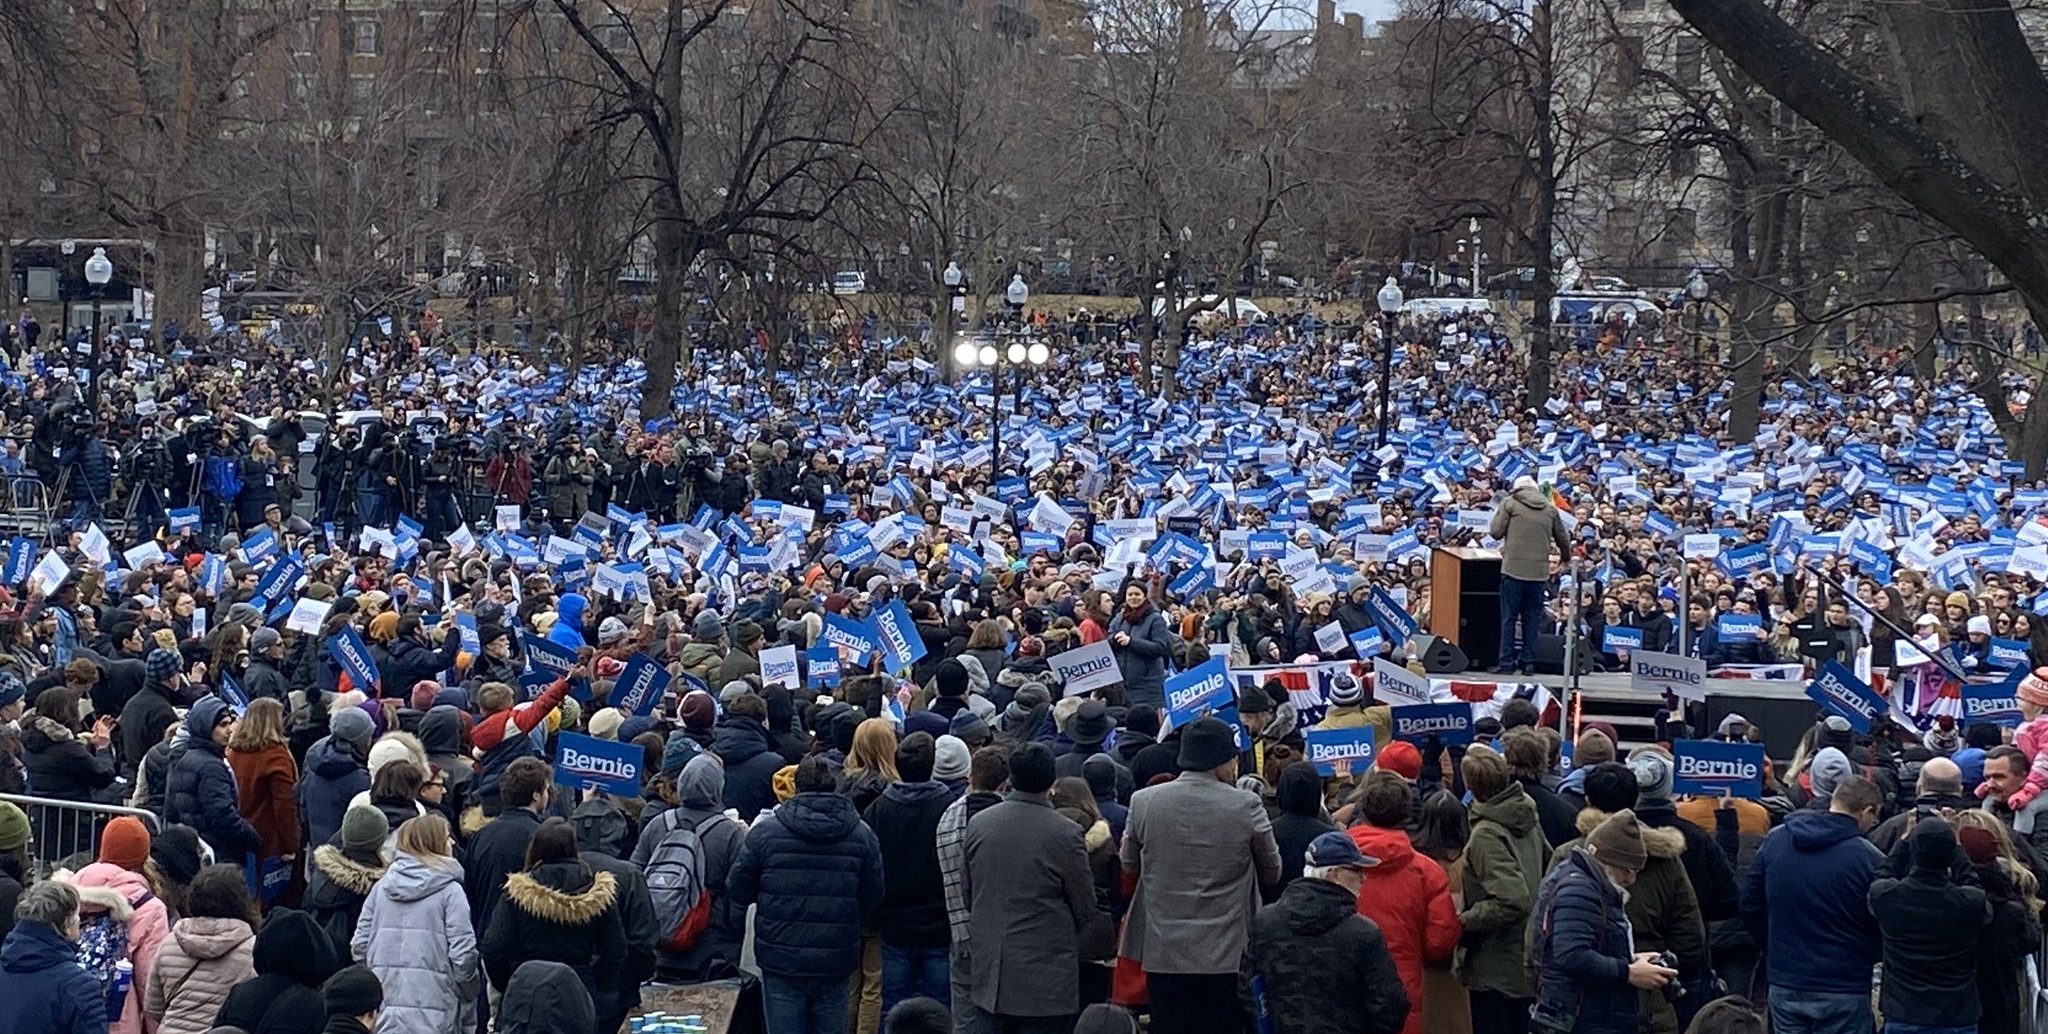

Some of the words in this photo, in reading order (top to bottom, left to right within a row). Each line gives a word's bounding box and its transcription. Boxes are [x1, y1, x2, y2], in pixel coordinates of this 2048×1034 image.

[1249, 539, 1284, 551] Bernie
[1731, 551, 1768, 569] Bernie
[263, 563, 296, 600] Bernie
[1371, 592, 1411, 637] Bernie
[825, 622, 872, 653] Bernie
[878, 608, 912, 664] Bernie
[1319, 629, 1342, 647] Bernie
[1354, 633, 1382, 649] Bernie
[1605, 633, 1641, 646] Bernie
[1721, 622, 1760, 635] Bernie
[336, 632, 375, 684] Bernie
[764, 658, 796, 676] Bernie
[808, 658, 839, 673] Bernie
[1057, 653, 1112, 681] Bernie
[1636, 660, 1701, 685] Bernie
[620, 662, 658, 711] Bernie
[1168, 672, 1225, 708] Bernie
[1378, 670, 1427, 702] Bernie
[1819, 671, 1878, 721] Bernie
[1965, 696, 2020, 714] Bern
[1397, 712, 1469, 735] Bernie
[561, 747, 637, 779] Bernie
[1311, 741, 1372, 761] Bernie
[1678, 754, 1758, 780] Bernie
